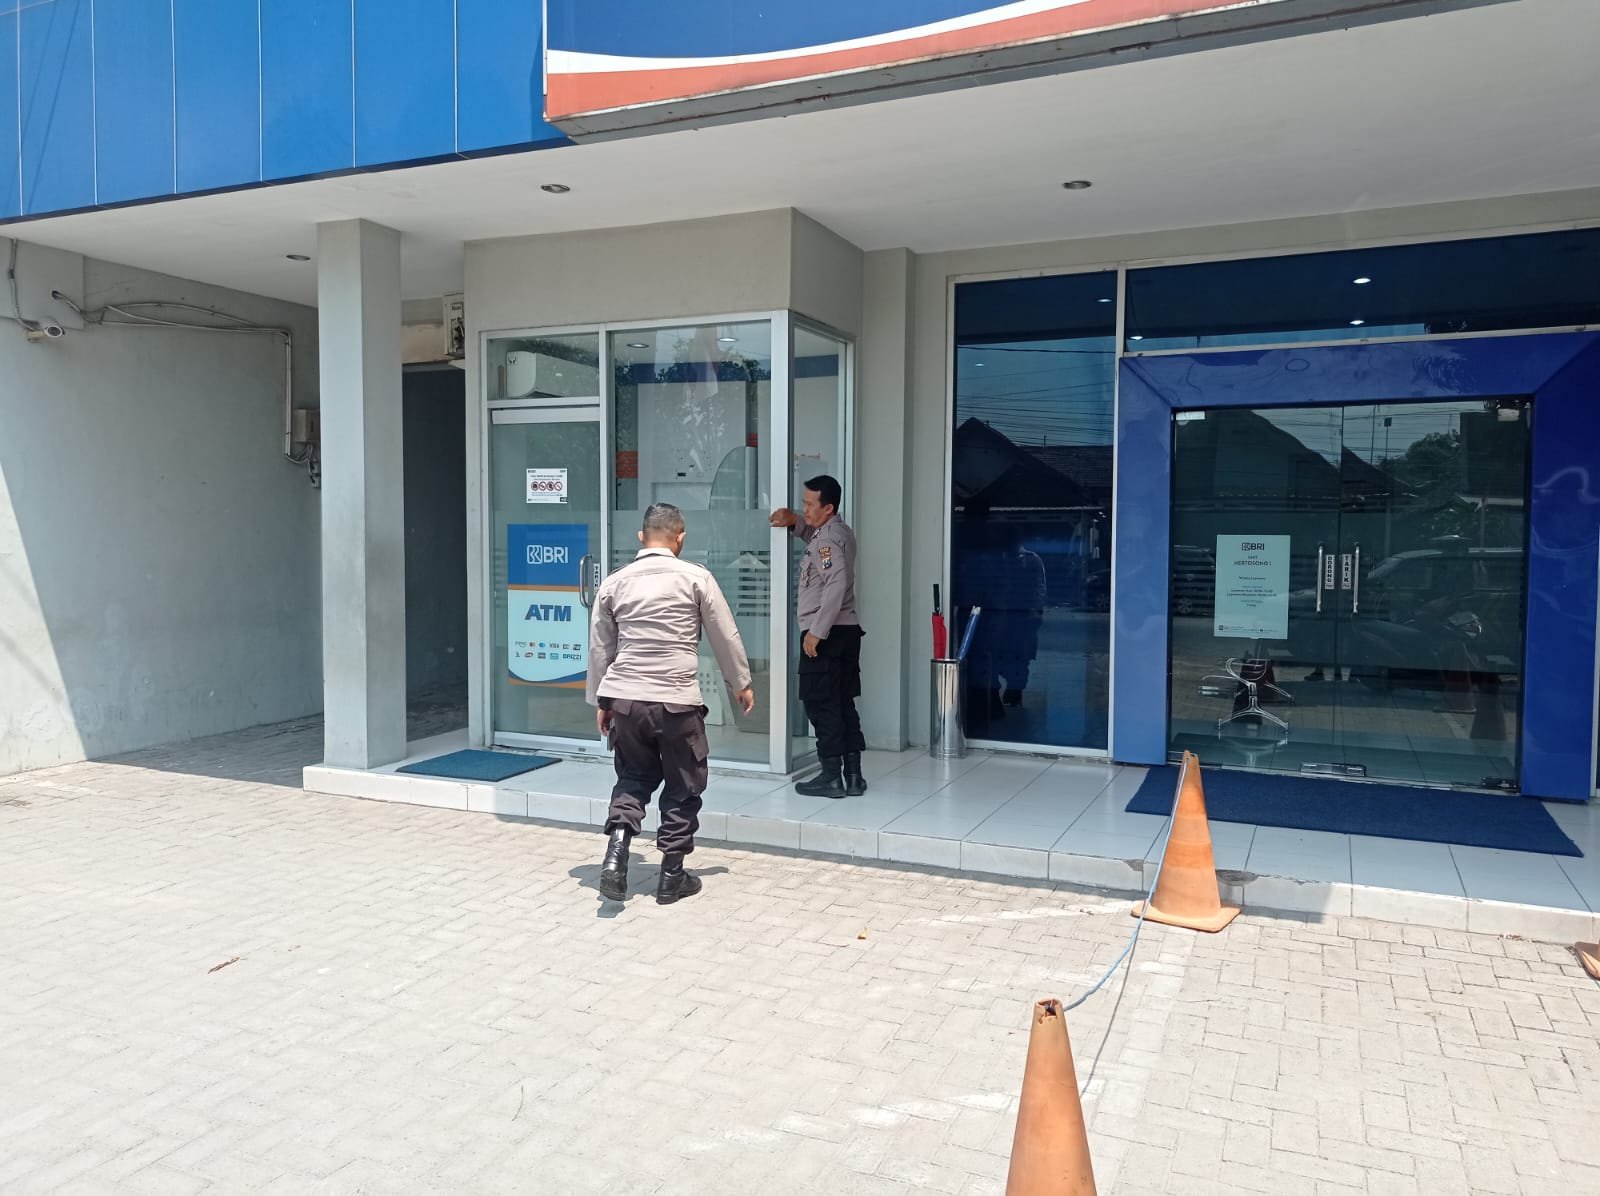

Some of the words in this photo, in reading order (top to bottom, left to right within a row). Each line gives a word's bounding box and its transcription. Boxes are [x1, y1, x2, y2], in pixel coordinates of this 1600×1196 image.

[543, 546, 569, 564] BRI
[1250, 543, 1264, 551] BRI
[525, 604, 572, 622] ATM
